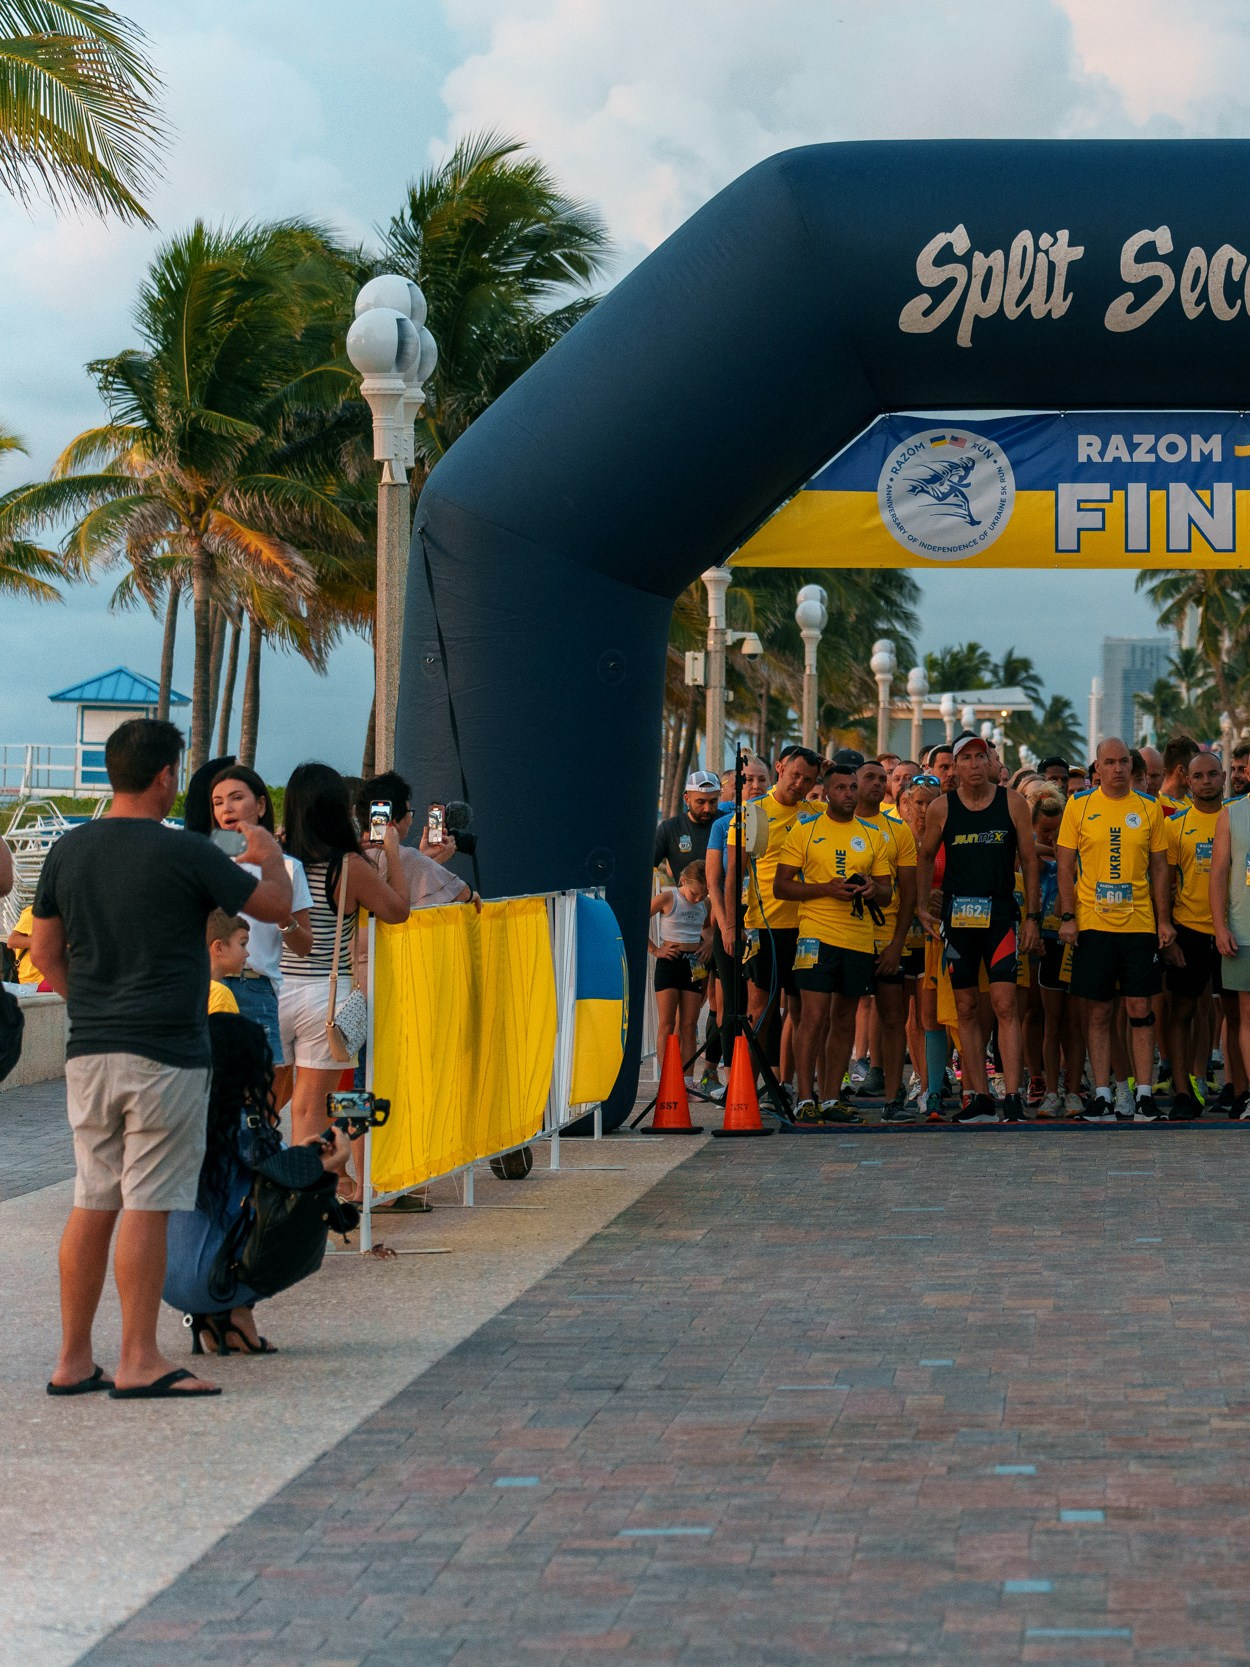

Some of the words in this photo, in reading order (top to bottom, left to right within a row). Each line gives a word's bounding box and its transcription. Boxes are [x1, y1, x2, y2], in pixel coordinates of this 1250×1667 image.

[899, 223, 1085, 347] Split
[1077, 433, 1222, 462] RAZOM
[890, 441, 926, 475] RAZOM
[970, 442, 994, 460] RUN
[996, 466, 1006, 483] RUN
[1000, 485, 1007, 495] 5K
[885, 484, 907, 535] ANNIVERSARY
[988, 498, 1007, 531] UKRAINE
[907, 534, 918, 543] OF
[978, 531, 989, 541] OF
[919, 538, 978, 553] INDEPENDENCE
[1110, 827, 1121, 879] UKRAINE
[1106, 890, 1123, 904] 60
[960, 904, 982, 918] 162
[659, 1102, 678, 1111] SST
